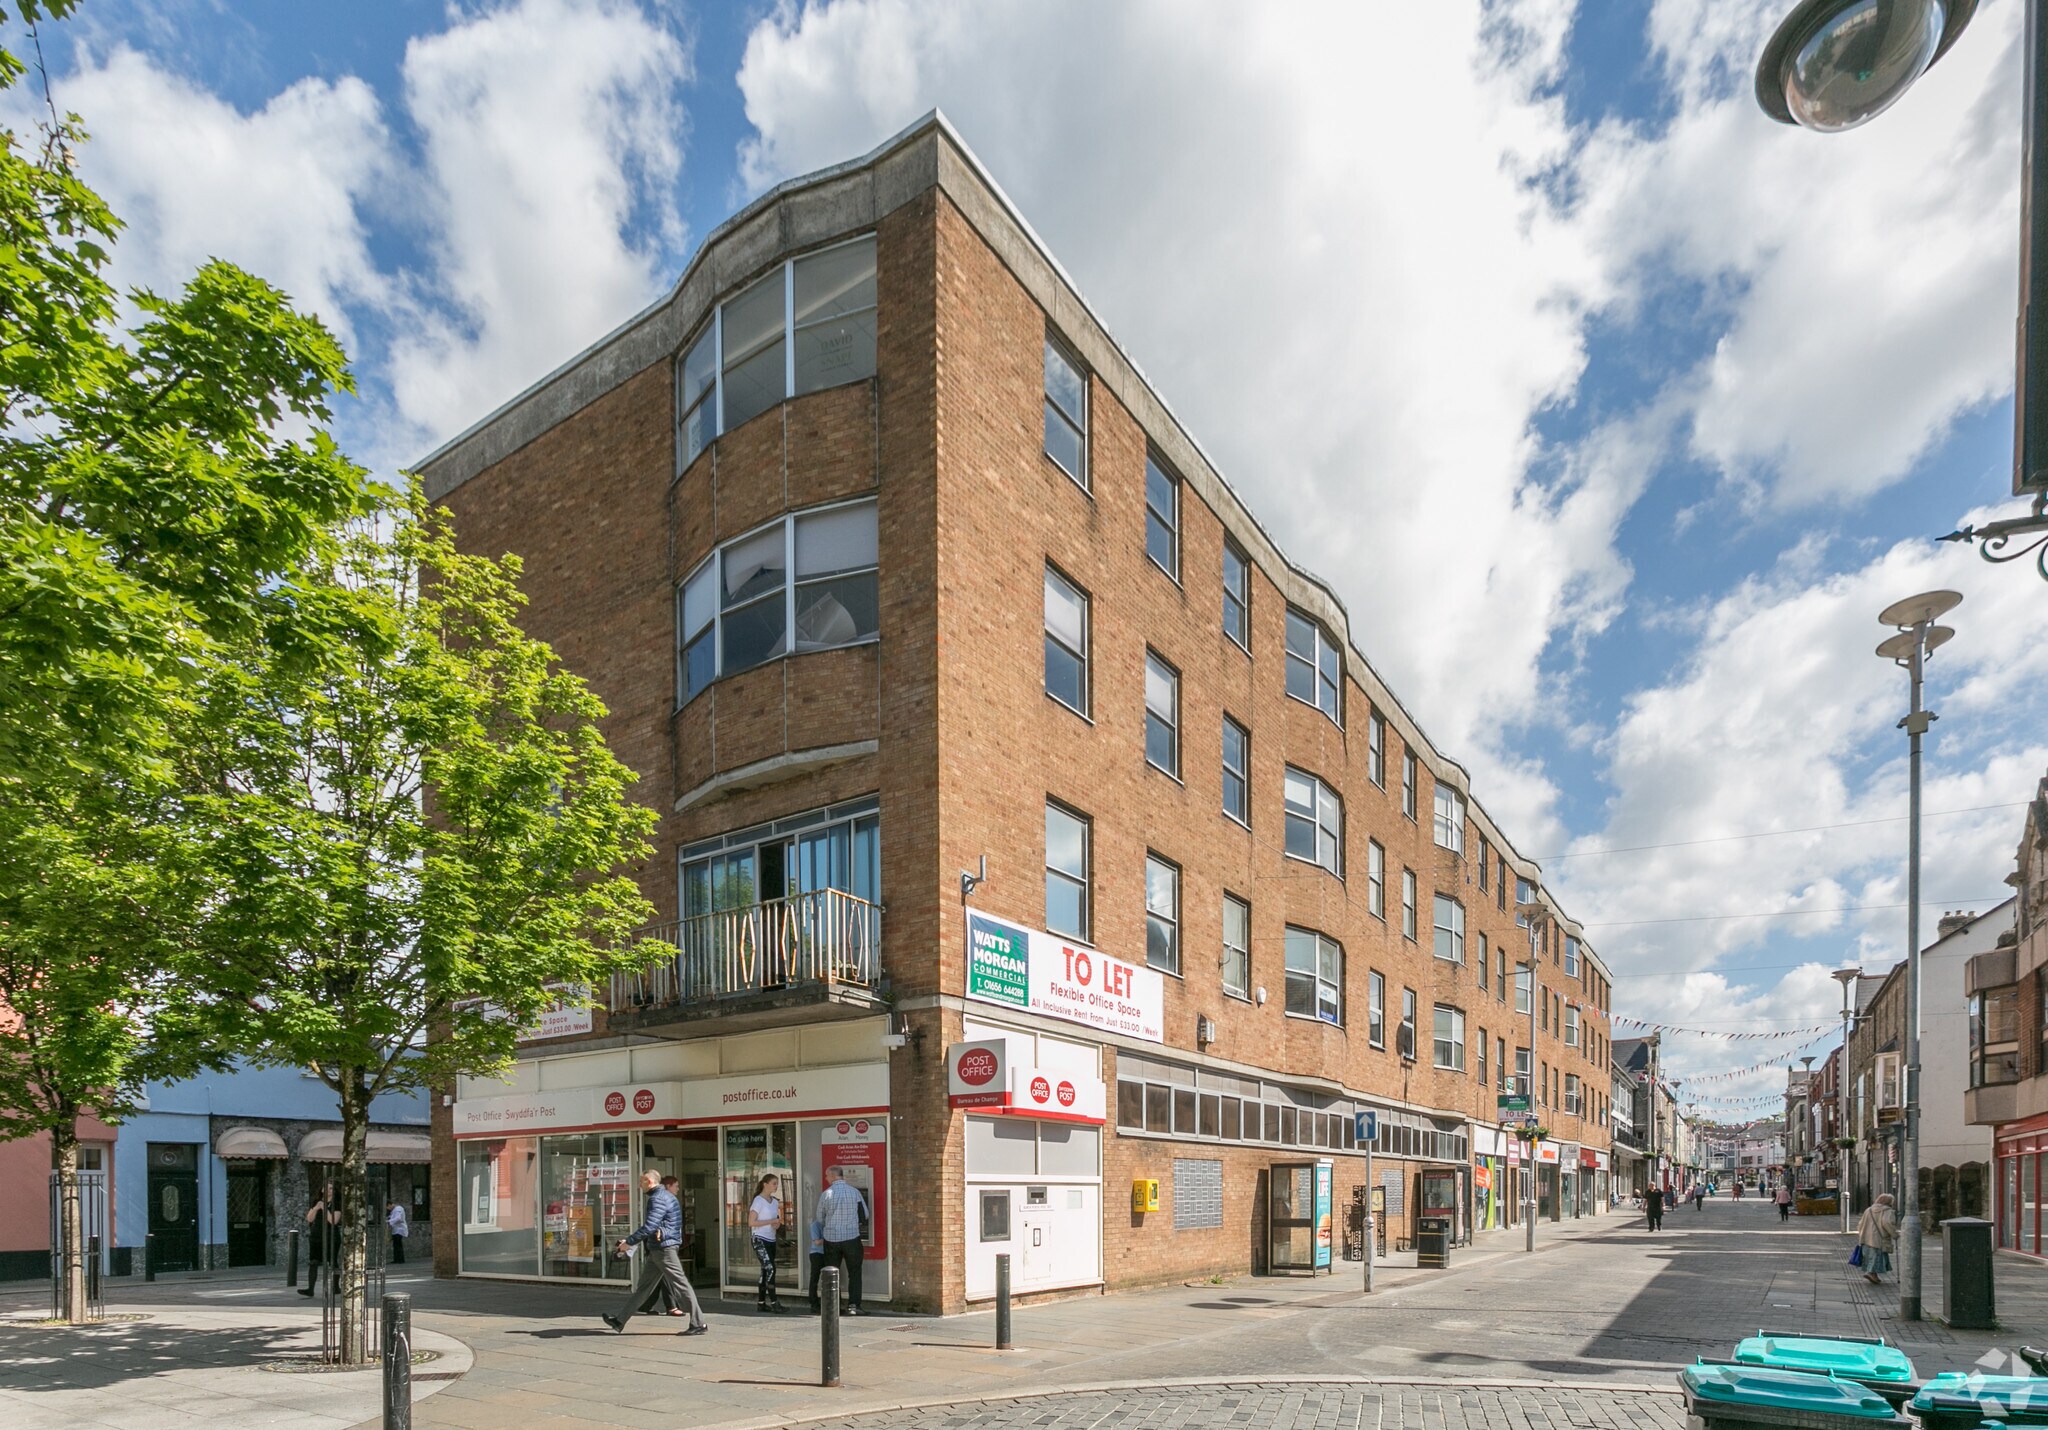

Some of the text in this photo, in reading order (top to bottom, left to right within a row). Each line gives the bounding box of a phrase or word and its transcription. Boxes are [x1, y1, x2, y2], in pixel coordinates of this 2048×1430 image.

[974, 929, 1010, 953] WATTS
[974, 947, 1025, 974] MORGAN
[974, 963, 1025, 984] COMMERCIAL
[1062, 947, 1133, 999] TO LET
[984, 980, 1002, 992] 01656
[1003, 985, 1024, 998] 644288
[1051, 982, 1141, 1018] Flexible Office Space
[549, 1016, 568, 1026] Space
[1031, 998, 1040, 1008] All
[1043, 1000, 1072, 1016] Inclusive
[1074, 1008, 1088, 1020] Rent
[1090, 1012, 1104, 1023] From
[1106, 1016, 1118, 1027] Just
[1120, 1020, 1140, 1032] £33.00
[554, 1025, 572, 1034] £33.00
[572, 1022, 589, 1032] /Week
[967, 1055, 989, 1066] POST
[961, 1065, 993, 1077] OFFICE
[1034, 1081, 1047, 1090] POST
[722, 1086, 797, 1106] postoffice.co.uk
[1032, 1089, 1048, 1098] OFFICE
[1059, 1092, 1073, 1101] POST
[608, 1096, 622, 1104] POST
[636, 1100, 652, 1109] POST
[981, 1096, 998, 1104] Change
[606, 1103, 624, 1111] OFFICE
[468, 1106, 555, 1122] Post Office Swyddfa'r Post
